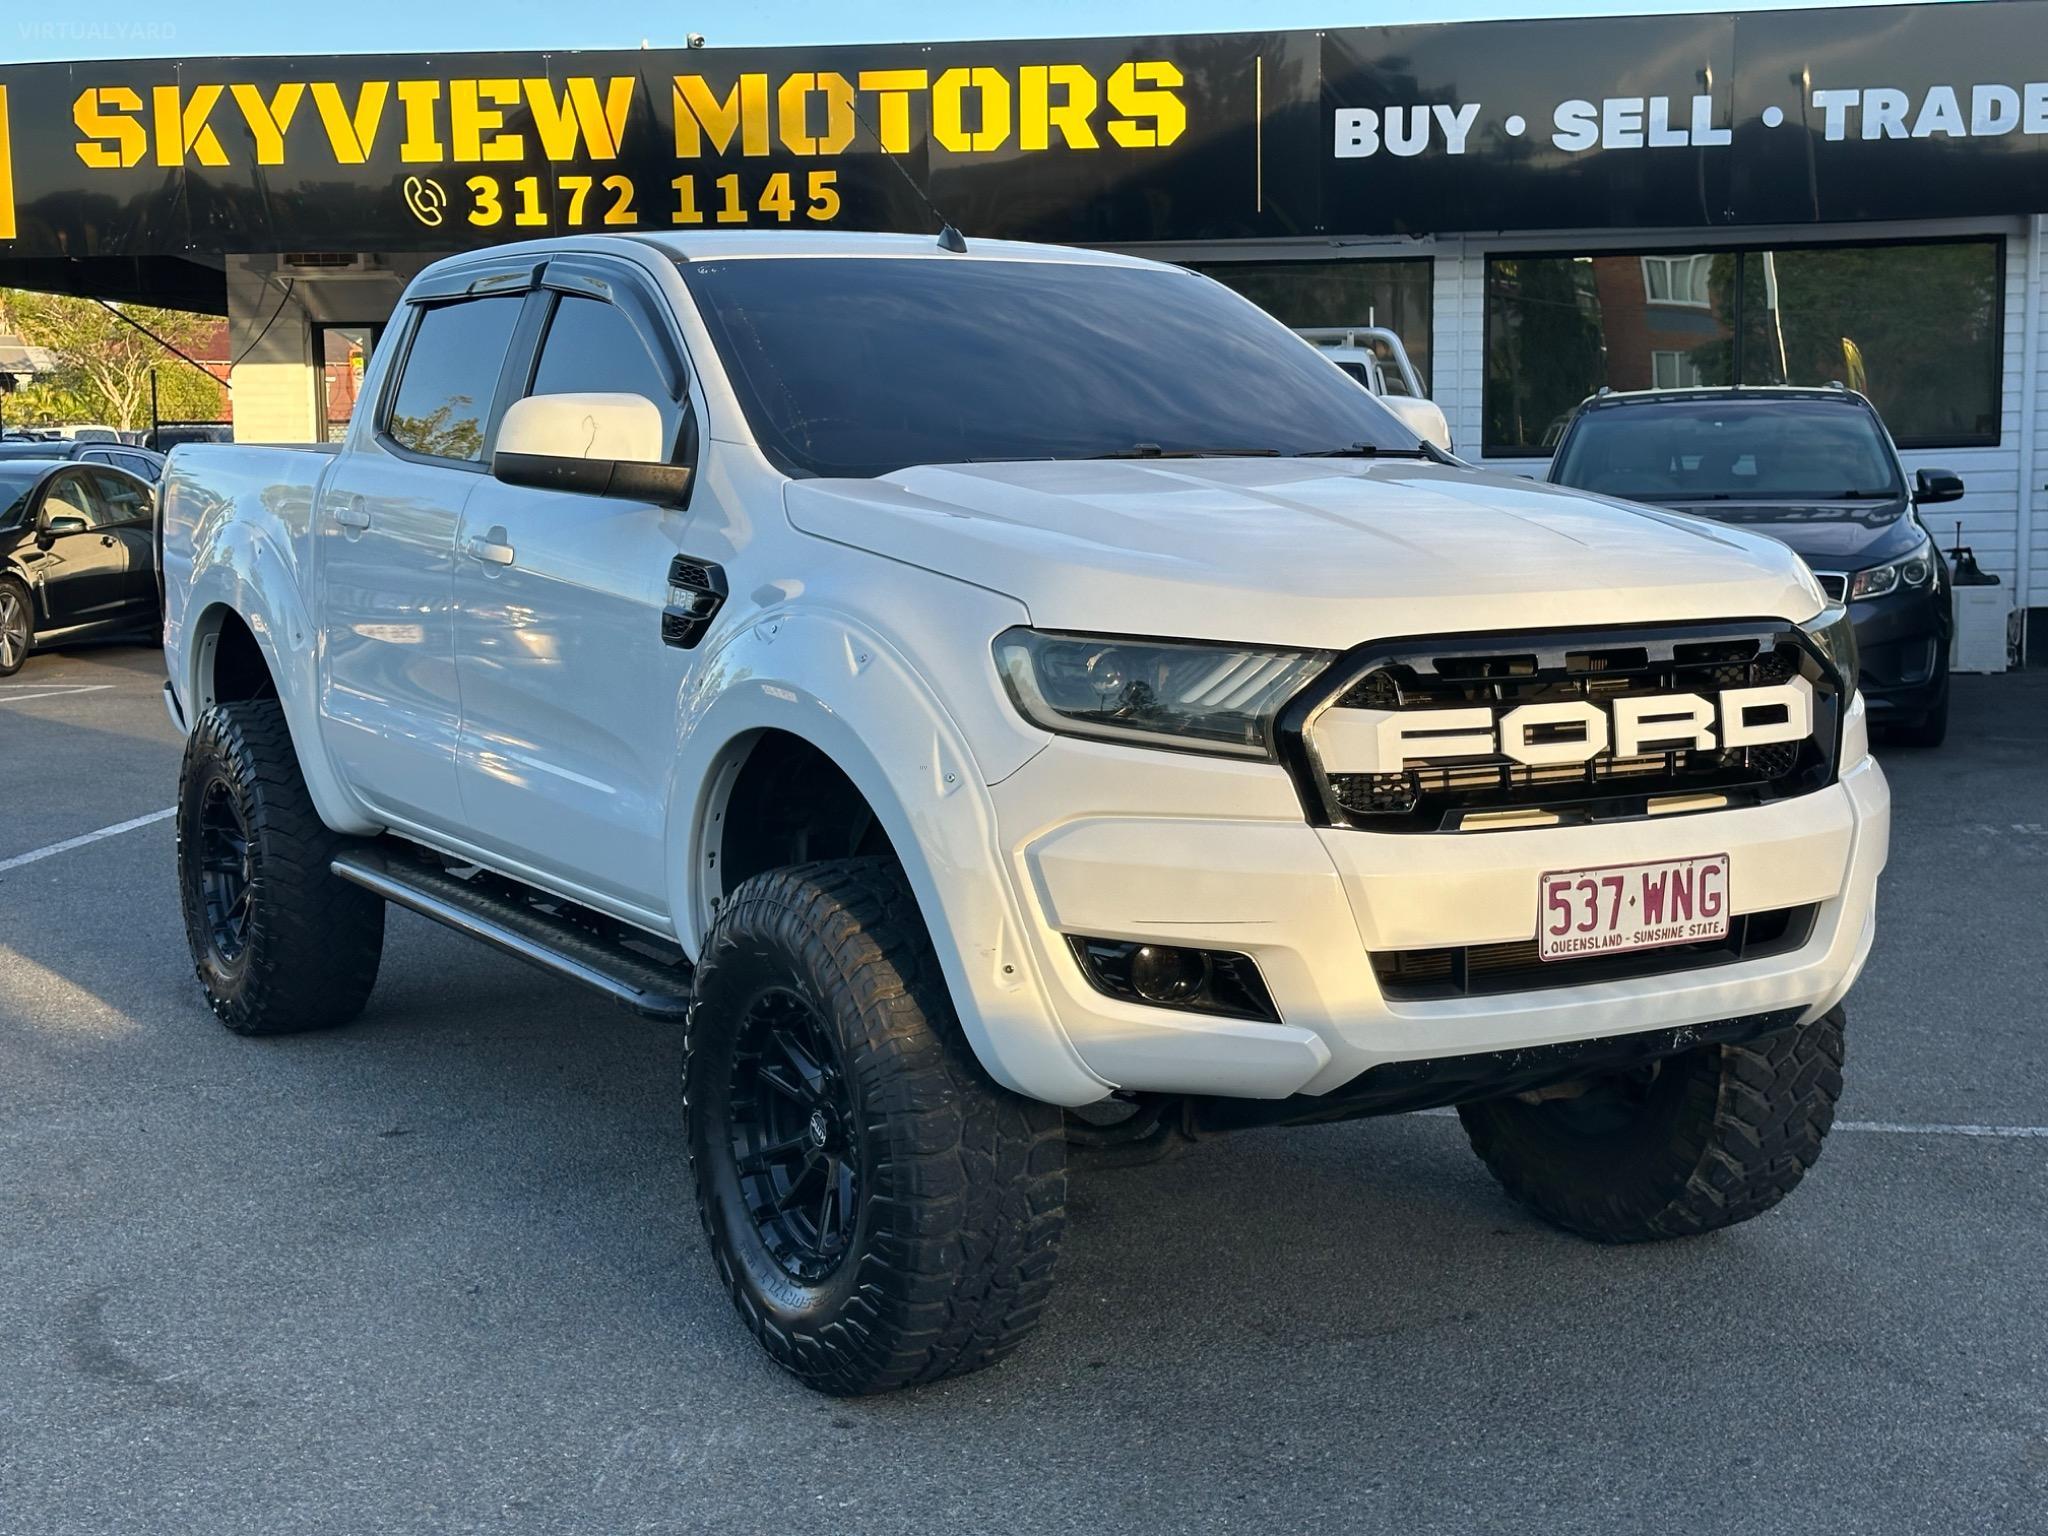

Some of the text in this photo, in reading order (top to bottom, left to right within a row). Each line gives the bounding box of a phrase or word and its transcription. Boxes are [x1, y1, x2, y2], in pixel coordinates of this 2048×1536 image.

[73, 61, 1187, 168] SKYVIEW MOTORS
[1335, 83, 2048, 158] BUY SELL TRADE
[466, 170, 841, 226] 3172 1145
[1313, 675, 1813, 773] FORD
[1548, 864, 1722, 936] 537 WNG
[1550, 922, 1720, 954] QUEENSLAND SUNSHINE STATE
